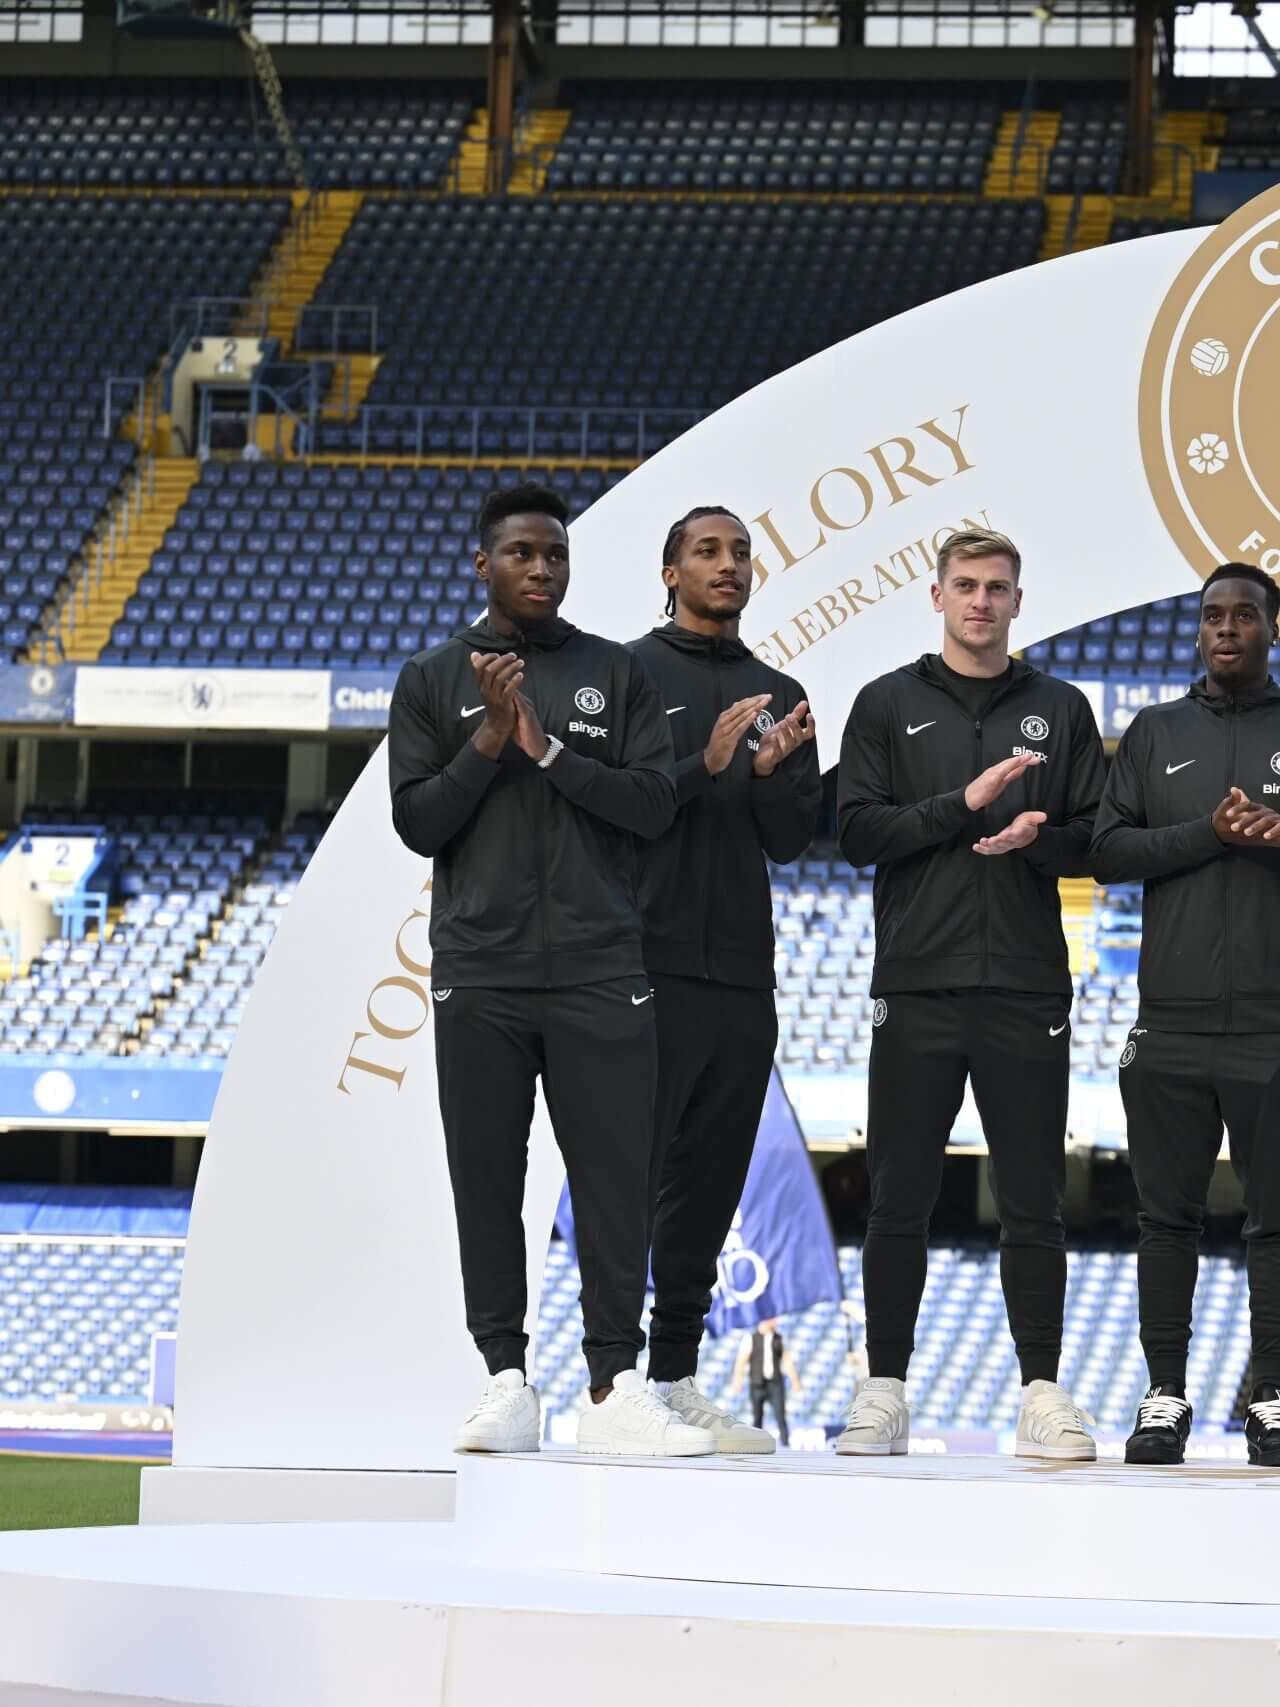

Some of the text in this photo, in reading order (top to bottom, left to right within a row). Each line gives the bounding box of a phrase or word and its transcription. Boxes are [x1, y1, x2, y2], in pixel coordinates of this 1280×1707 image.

[224, 338, 238, 360] 2
[750, 404, 976, 597] LORY
[55, 843, 70, 867] 2
